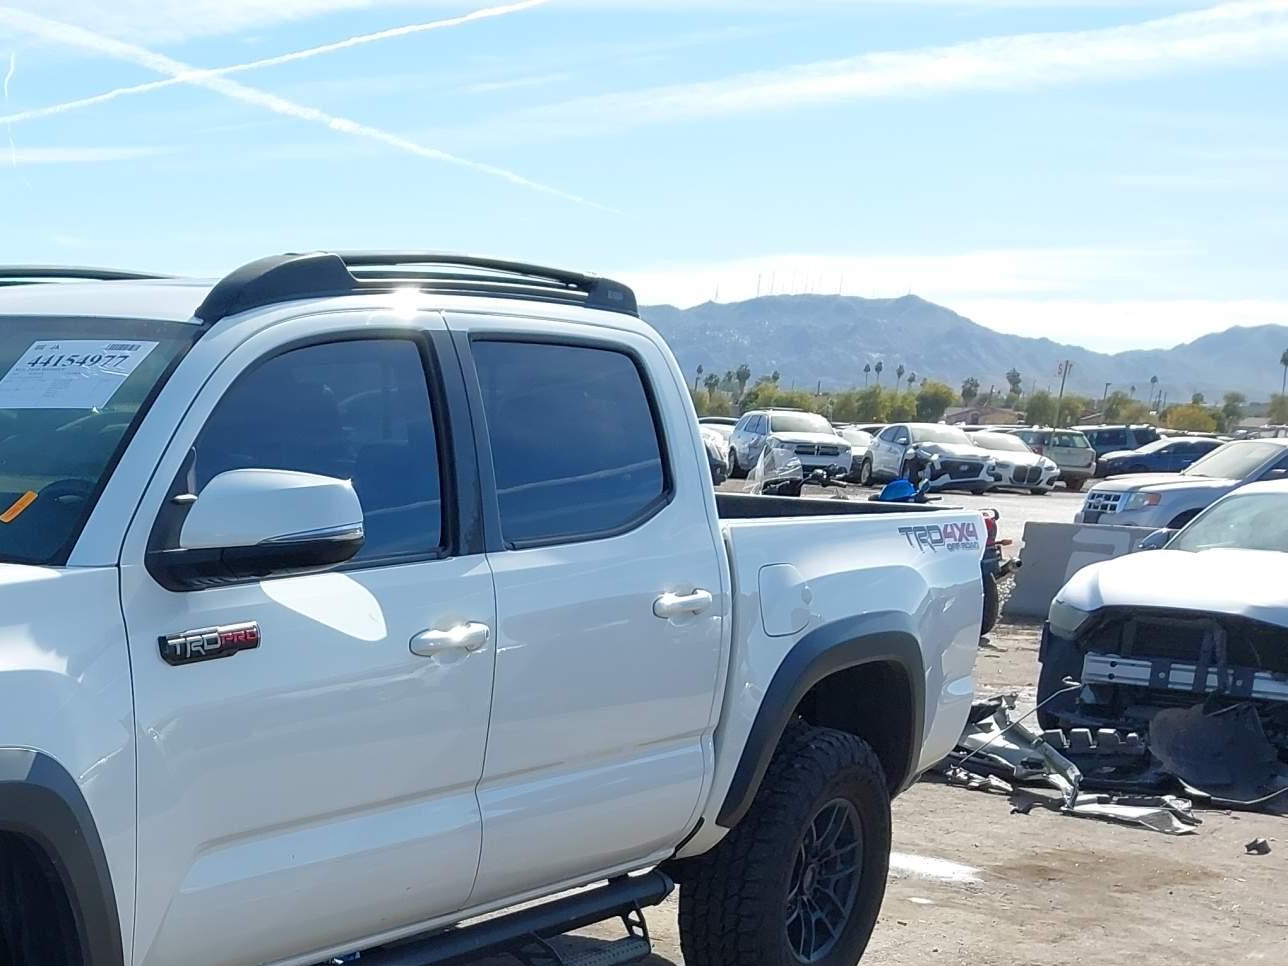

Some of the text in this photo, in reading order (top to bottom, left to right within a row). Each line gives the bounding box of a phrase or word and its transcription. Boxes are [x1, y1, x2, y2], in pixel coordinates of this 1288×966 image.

[27, 353, 130, 368] 44154977
[167, 627, 258, 659] TRD PRO
